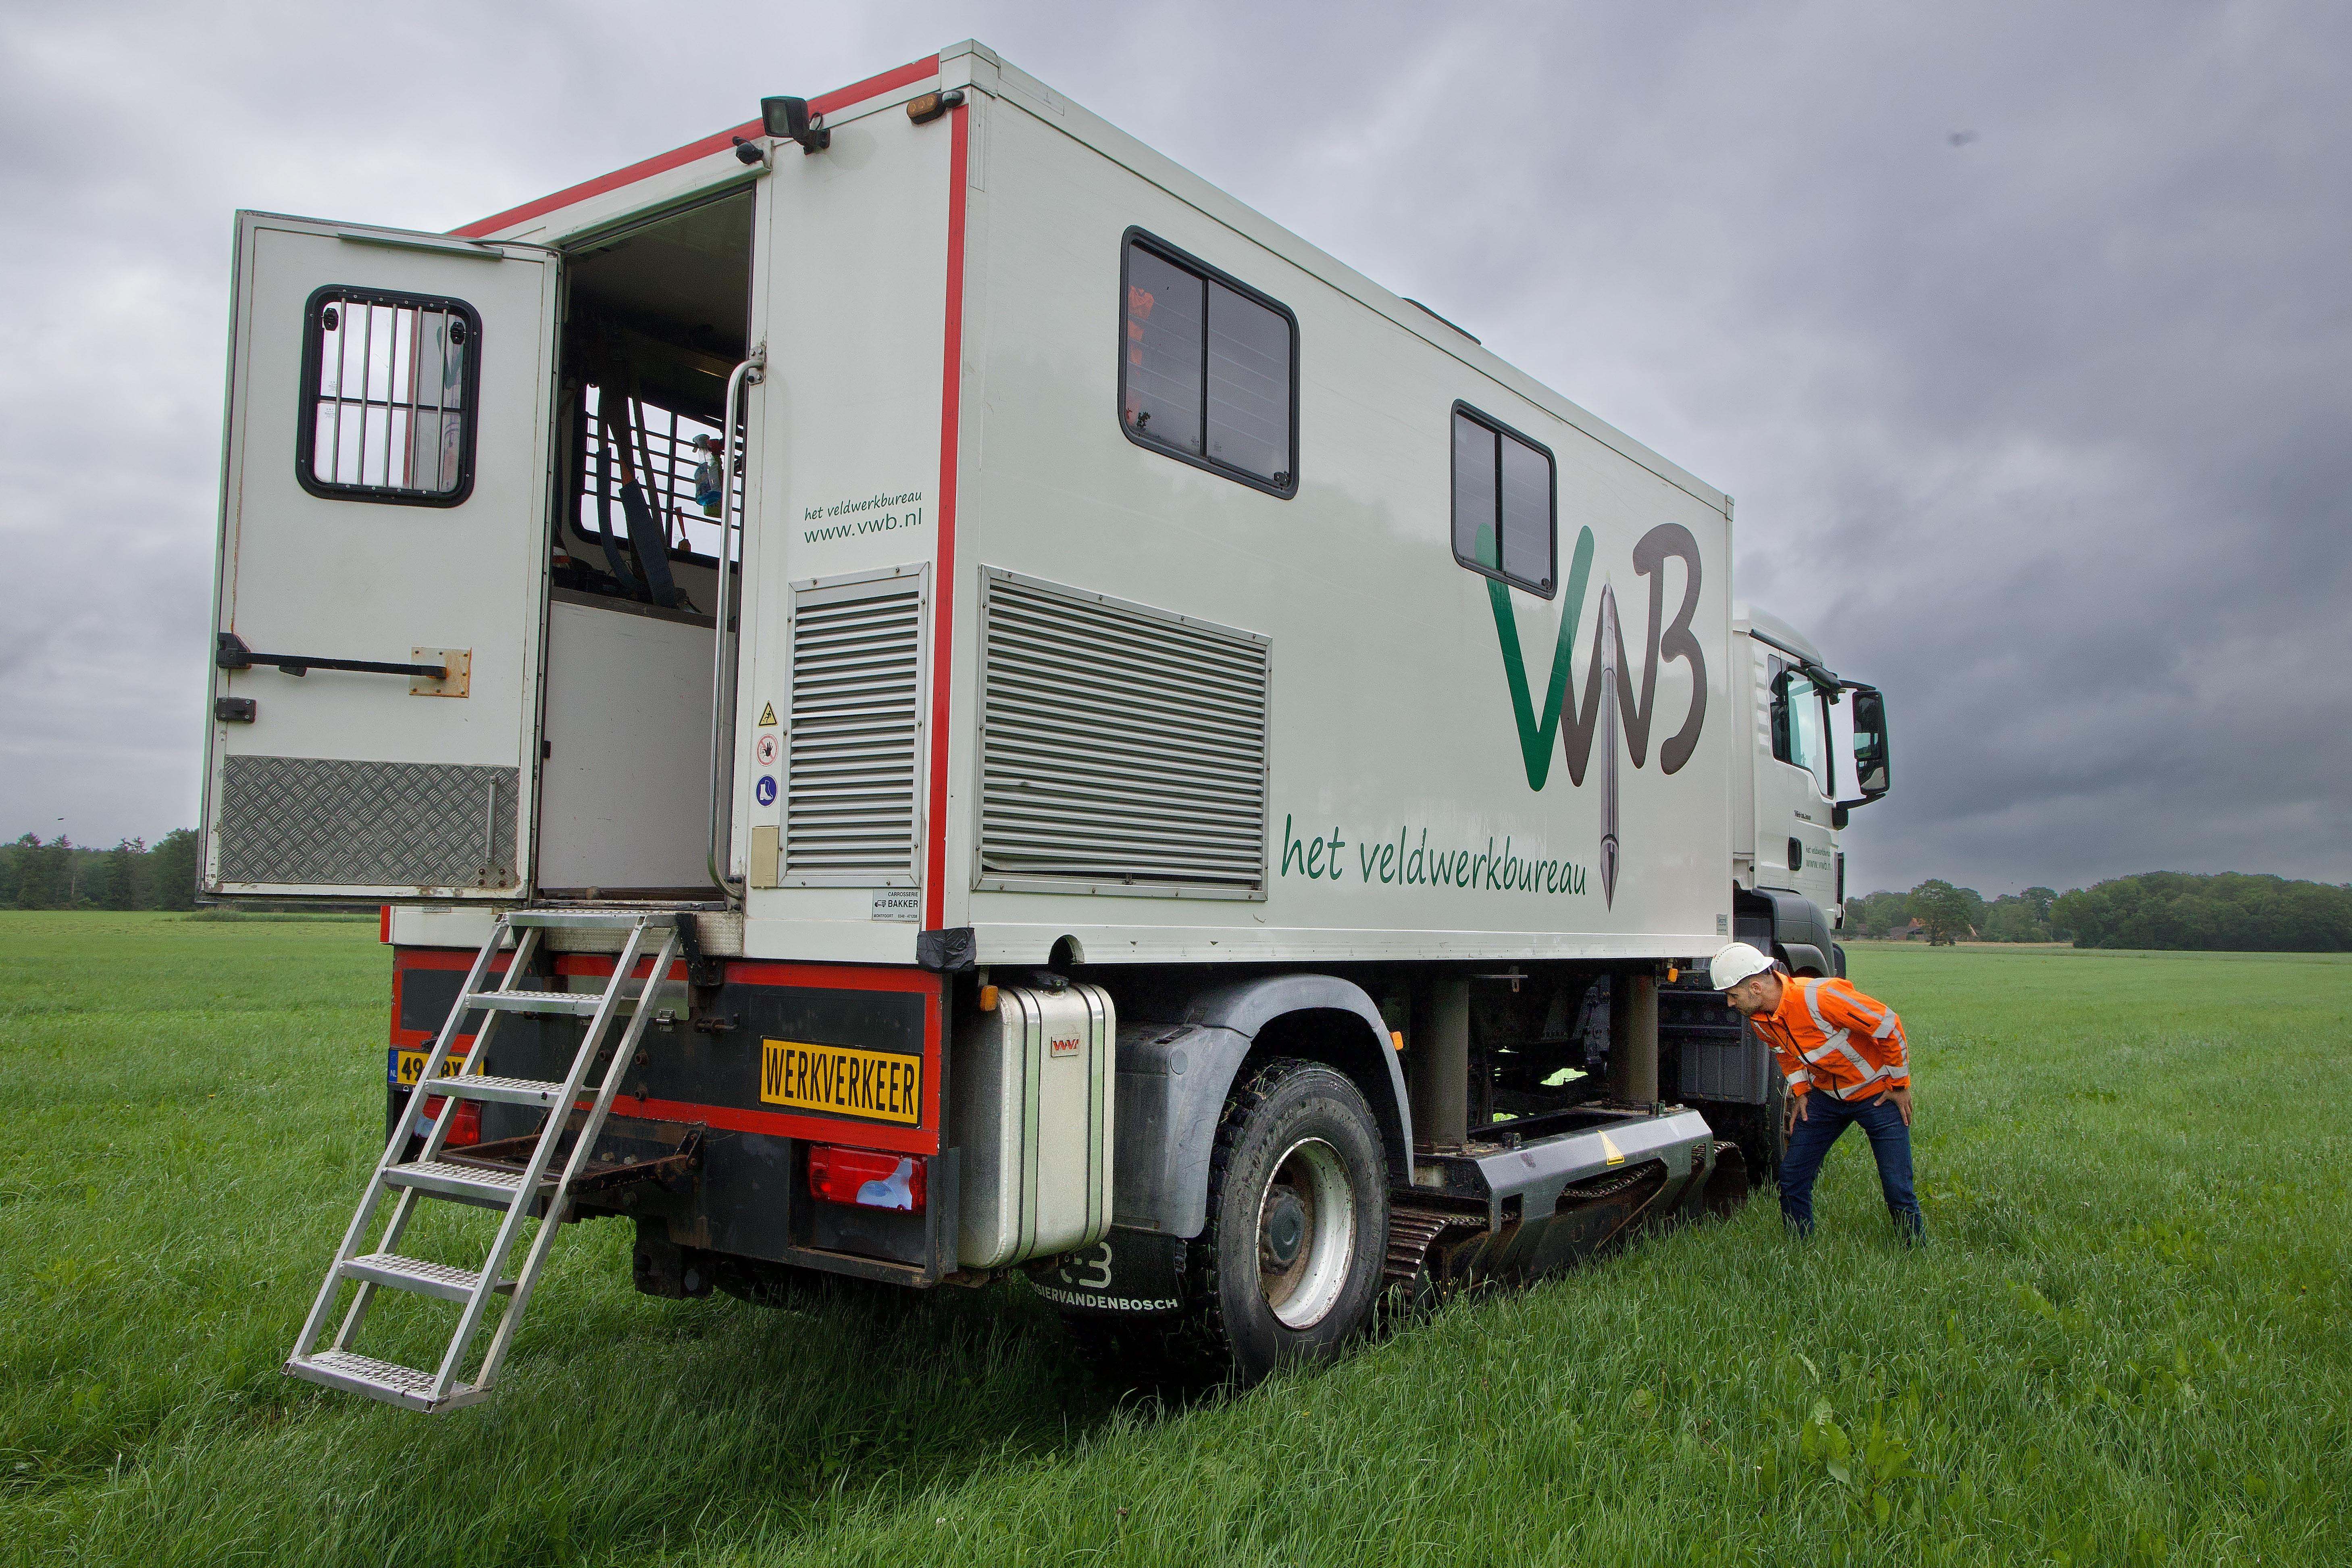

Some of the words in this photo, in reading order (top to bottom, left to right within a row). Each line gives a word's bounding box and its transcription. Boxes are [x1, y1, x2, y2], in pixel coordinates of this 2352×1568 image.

[804, 508, 922, 543] www.vwb.nl
[805, 507, 823, 521] het
[828, 491, 922, 517] veldwerkbureau
[1281, 813, 1345, 880] het
[1361, 825, 1586, 895] veldwerkbureau
[766, 1047, 914, 1115] WERKVERKEER
